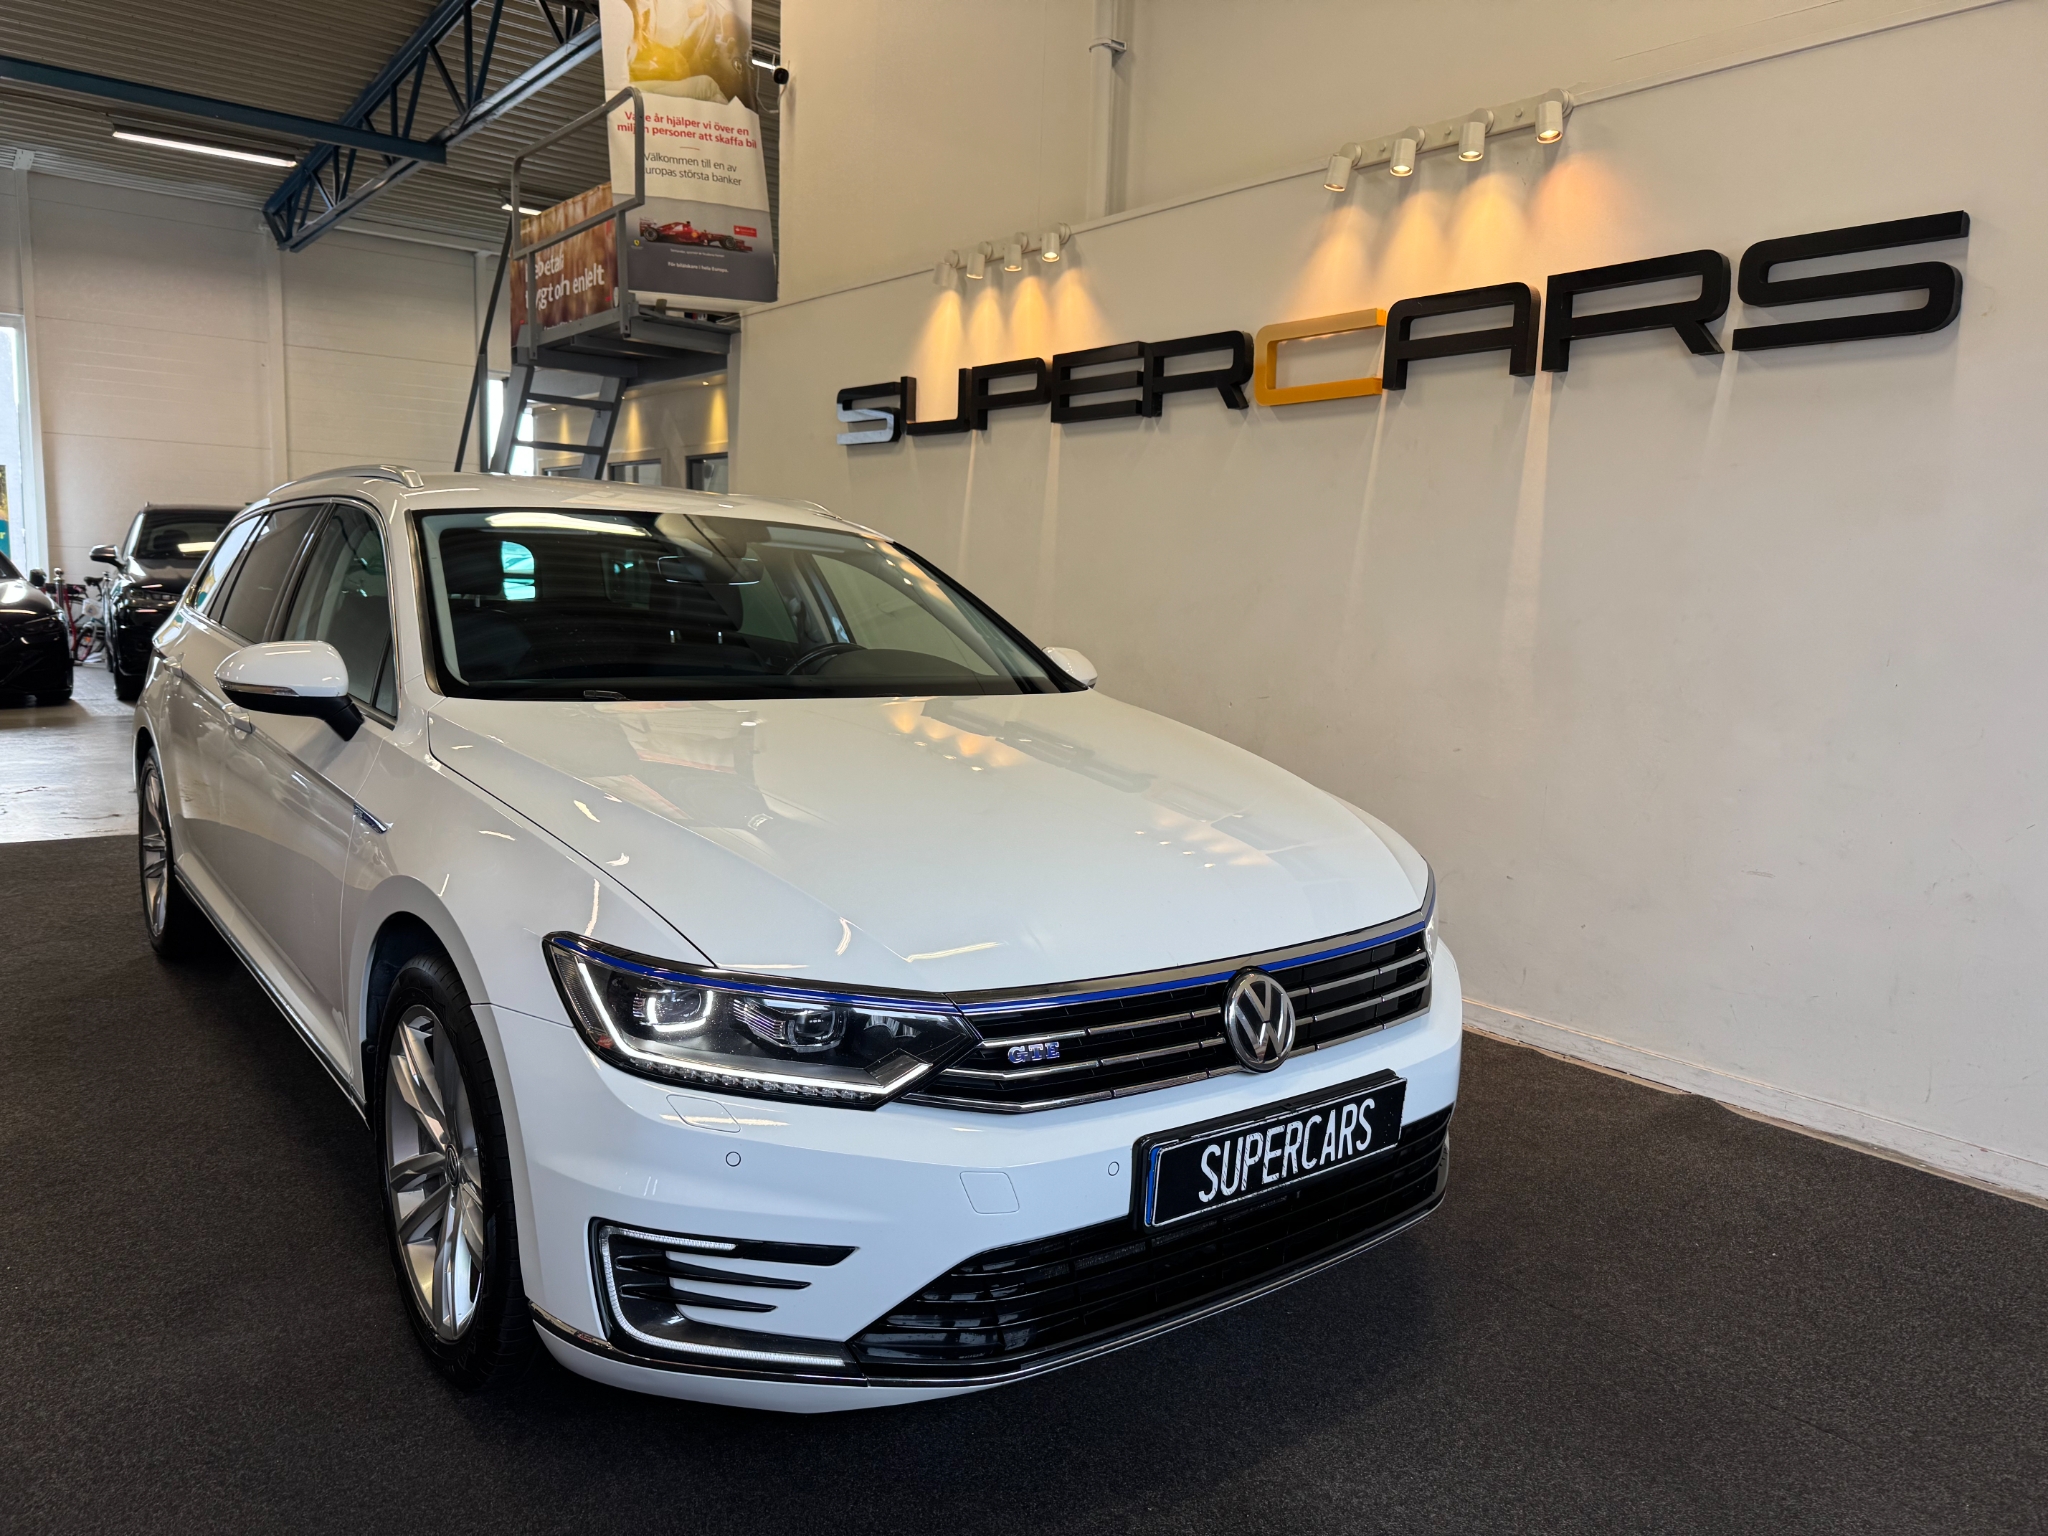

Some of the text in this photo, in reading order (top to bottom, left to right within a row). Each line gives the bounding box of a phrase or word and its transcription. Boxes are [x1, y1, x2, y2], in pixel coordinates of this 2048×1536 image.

[654, 112, 664, 124] år
[666, 114, 701, 129] hjälper
[702, 121, 712, 130] vi
[713, 122, 734, 134] över
[737, 127, 749, 136] en
[652, 126, 696, 140] personer
[698, 133, 713, 142] att
[715, 135, 744, 147] skaffa
[745, 139, 757, 149] bil
[644, 152, 737, 173] Välkommen till en av
[644, 167, 742, 186] uropas största banker
[837, 210, 1970, 446] SUPERCARS
[1007, 1041, 1060, 1064] GTE
[1198, 1098, 1376, 1203] SUPERCARS
